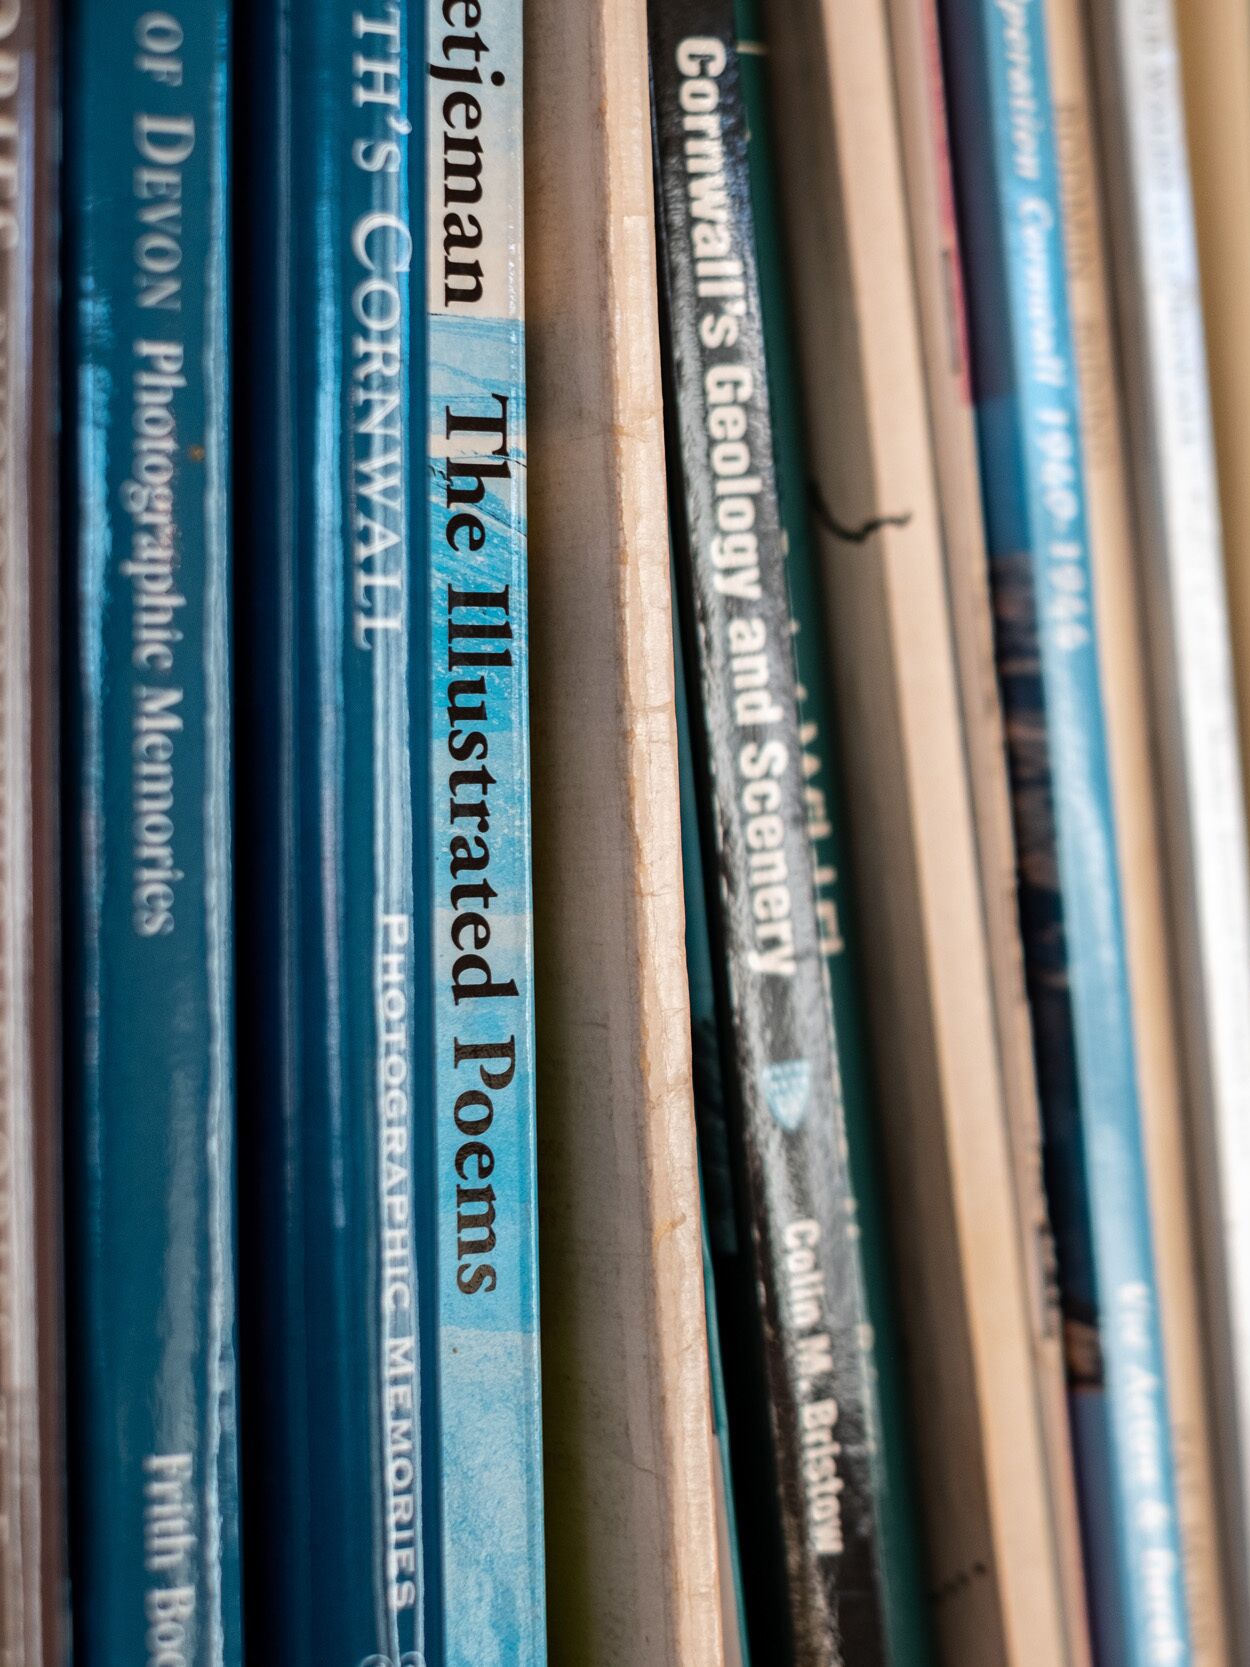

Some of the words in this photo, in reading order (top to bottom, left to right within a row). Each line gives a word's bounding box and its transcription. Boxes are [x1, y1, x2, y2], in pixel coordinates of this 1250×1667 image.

[133, 12, 184, 86] OF
[426, 0, 506, 306] etjeman
[133, 114, 195, 310] DEVON
[675, 37, 747, 347] Cornwall's
[120, 340, 187, 670] Photographic
[352, 211, 414, 650] CORNWALL
[444, 394, 510, 552] The
[708, 364, 764, 599] Geology
[728, 617, 784, 725] and
[132, 687, 187, 936] Memories
[445, 584, 520, 1006] Illustrated
[739, 740, 797, 976] Scenery
[380, 914, 413, 1311] PHOTOGRAPHIC
[452, 1035, 518, 1296] Poems
[783, 1219, 825, 1328] Colin
[796, 1334, 835, 1391] M.
[142, 1453, 198, 1572] Frith
[384, 1337, 417, 1611] MEMORIES
[802, 1399, 845, 1556] Bristow
